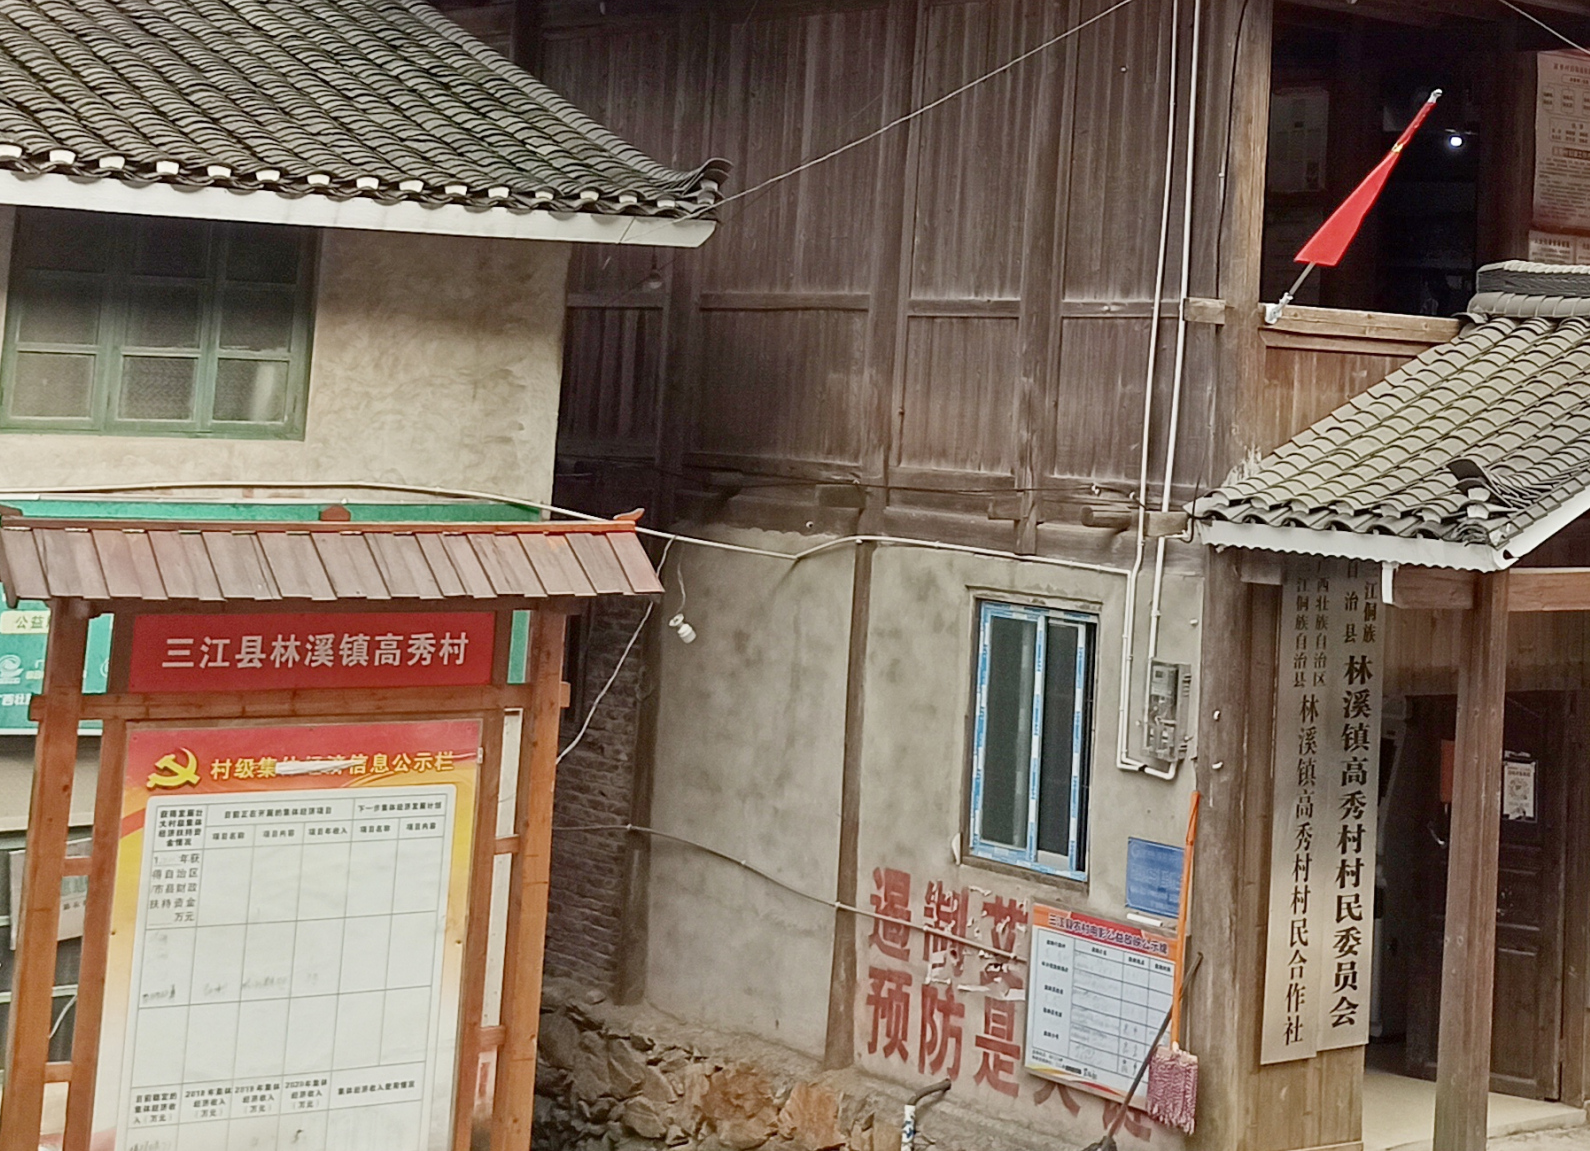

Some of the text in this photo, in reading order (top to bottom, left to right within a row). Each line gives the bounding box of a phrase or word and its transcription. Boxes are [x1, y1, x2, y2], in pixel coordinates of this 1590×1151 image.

[15, 616, 50, 629] 公益
[162, 632, 469, 670] 三江县林溪镇高秀村
[1293, 569, 1309, 688] 江侗族自治县
[1282, 694, 1320, 1046] 林溪镇高秀村村民合作社
[1329, 655, 1373, 1028] 林溪镇高秀村村民委员会
